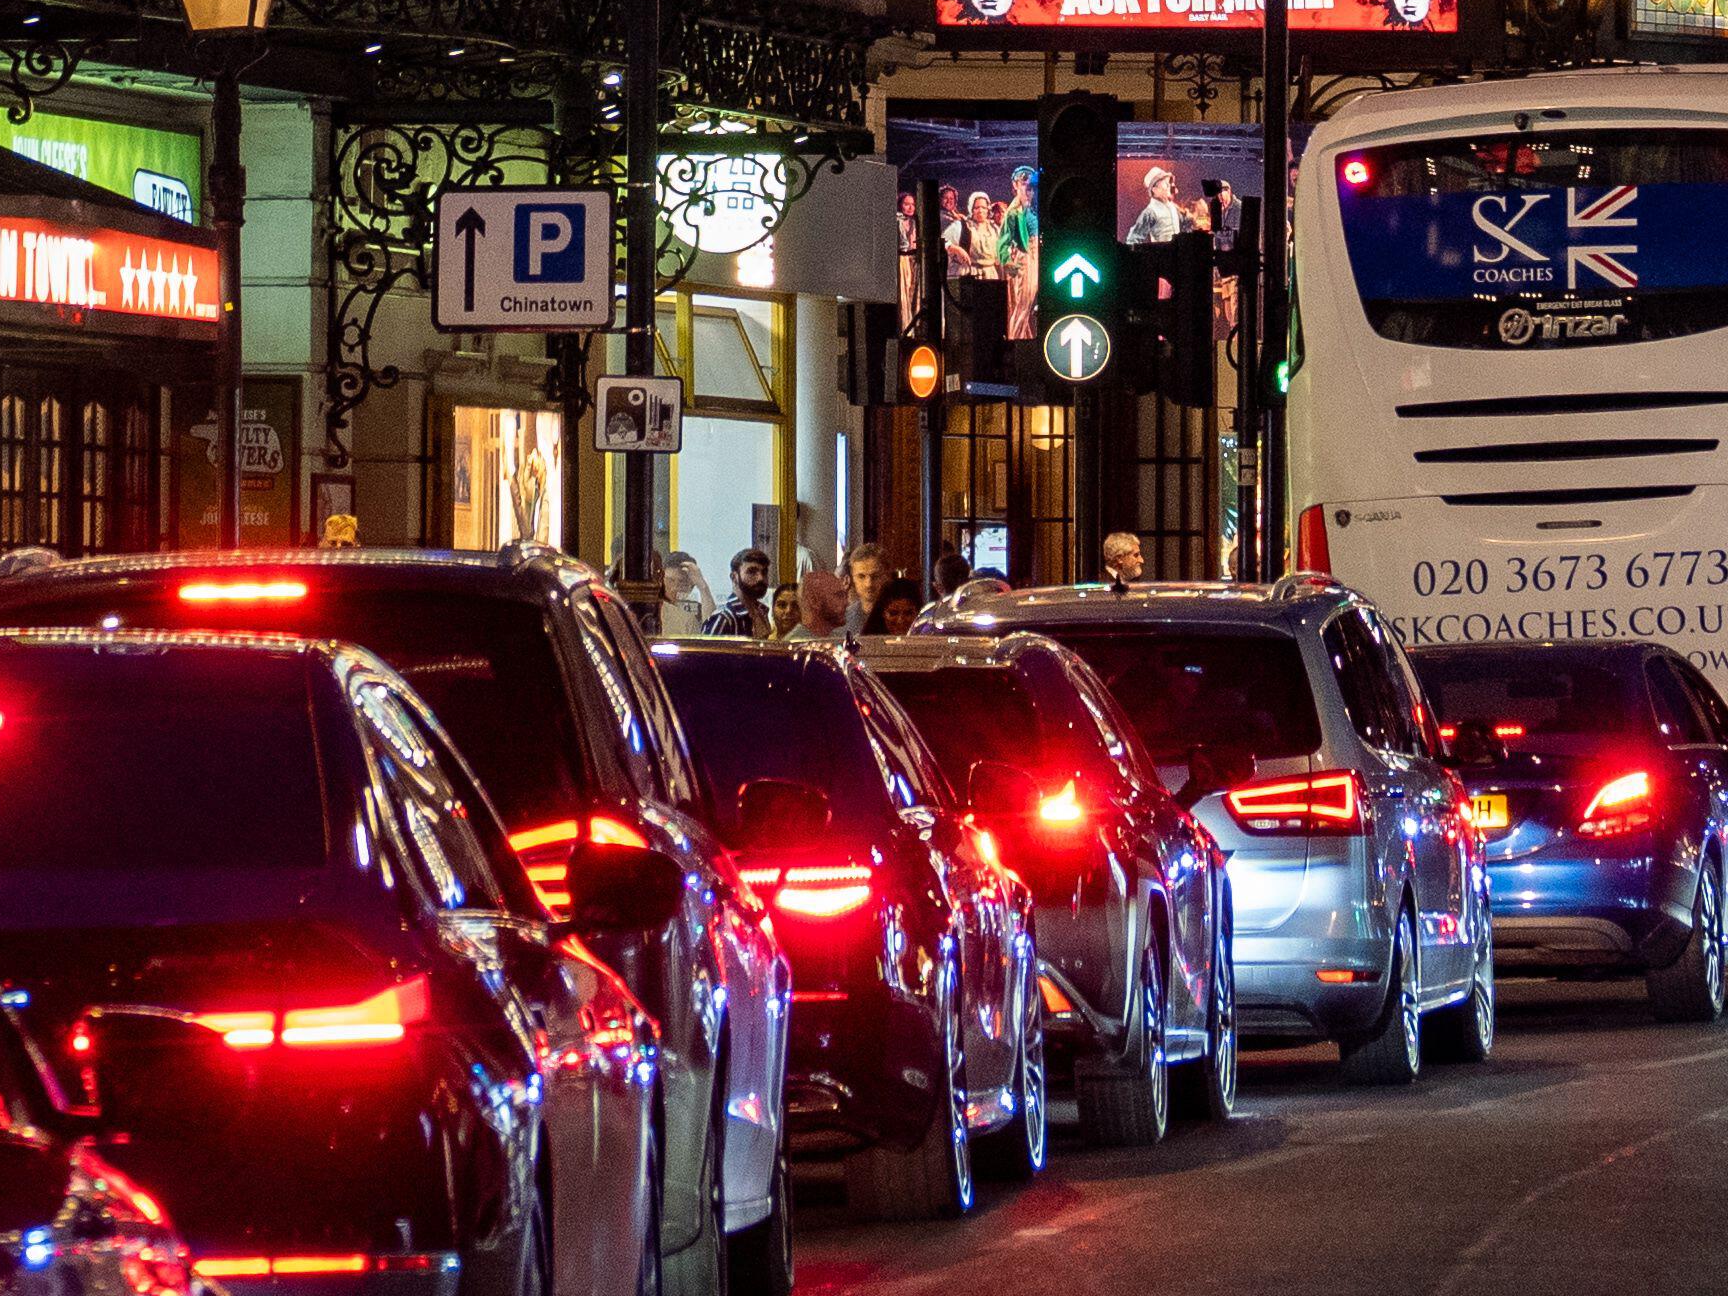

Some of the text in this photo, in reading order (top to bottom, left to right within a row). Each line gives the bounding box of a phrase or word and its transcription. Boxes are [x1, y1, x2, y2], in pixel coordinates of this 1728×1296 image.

[528, 211, 571, 275] P
[1473, 268, 1553, 282] COACHES
[499, 296, 594, 313] Chinatown
[1412, 559, 1488, 597] 020
[1506, 554, 1608, 594] 3673
